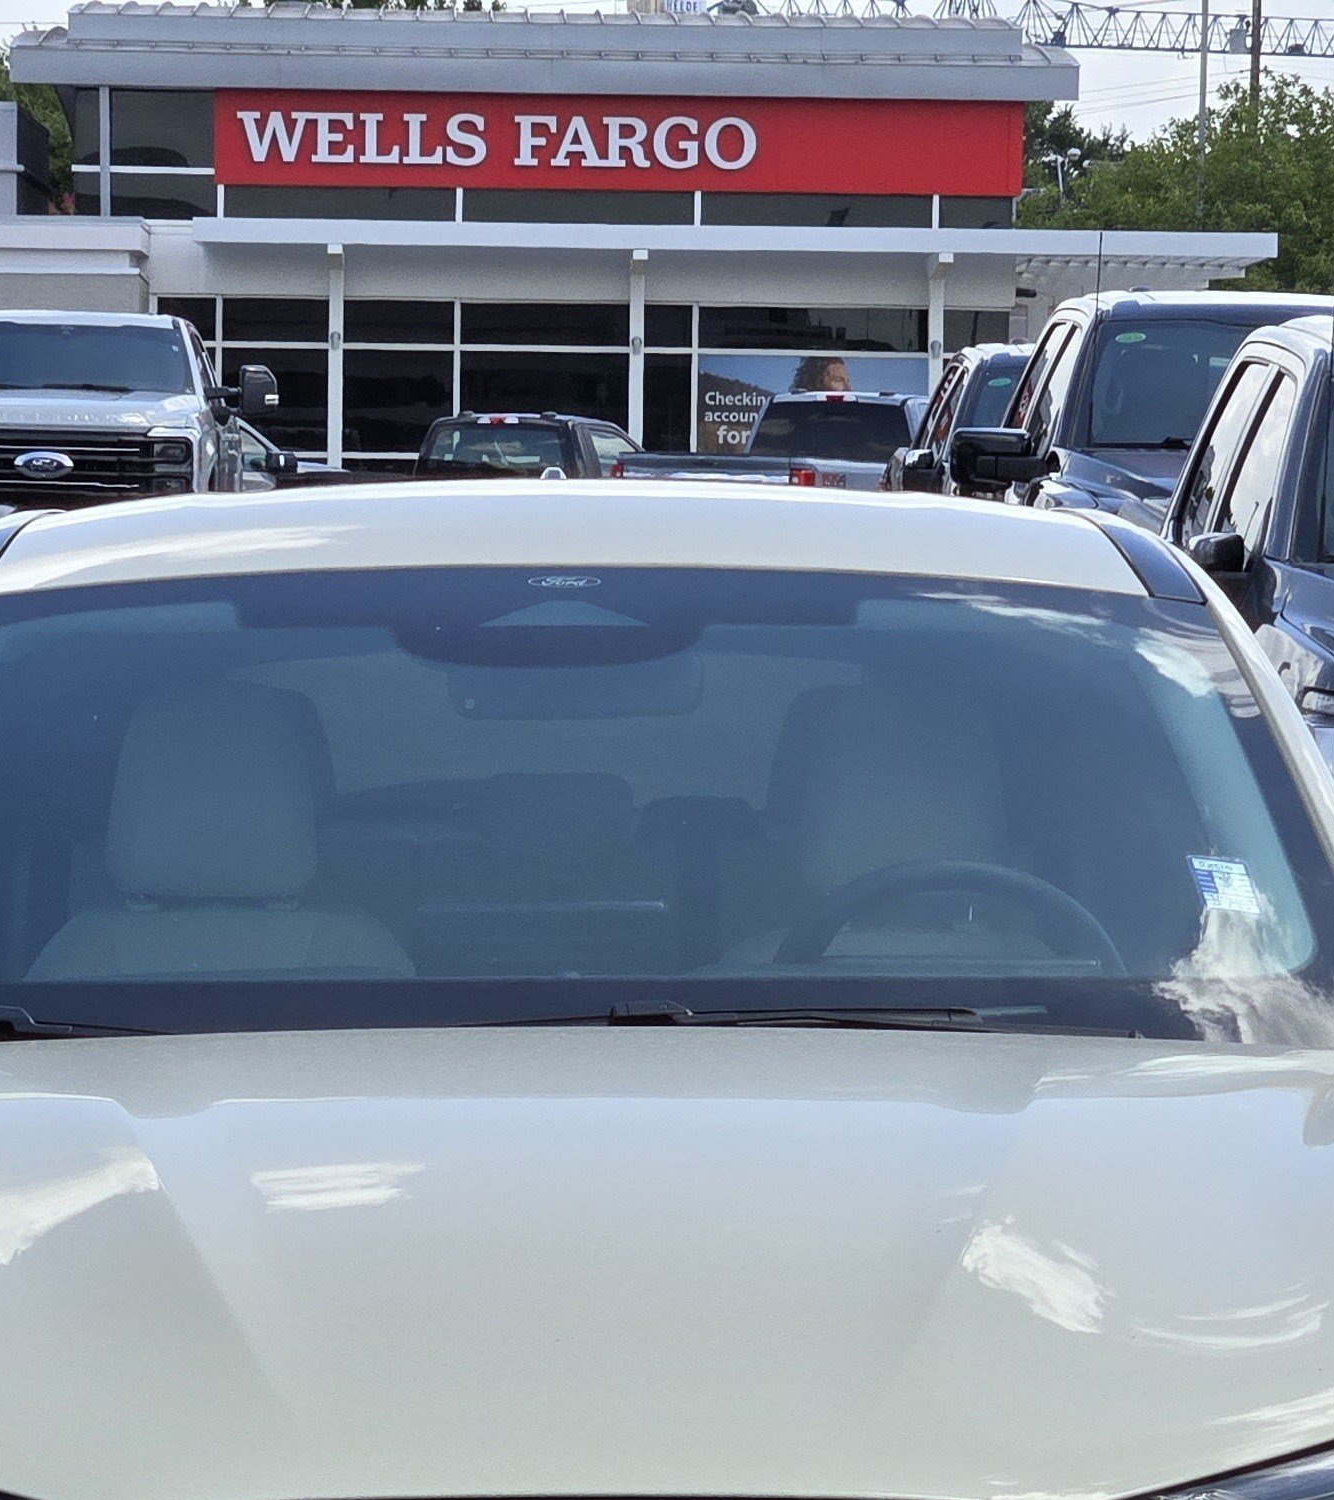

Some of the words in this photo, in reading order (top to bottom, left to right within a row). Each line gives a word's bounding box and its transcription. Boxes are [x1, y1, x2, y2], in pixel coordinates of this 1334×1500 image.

[236, 110, 488, 166] WELLS
[513, 115, 758, 170] FARGO
[704, 410, 759, 422] accoun
[717, 425, 751, 444] for
[541, 577, 588, 588] Ford
